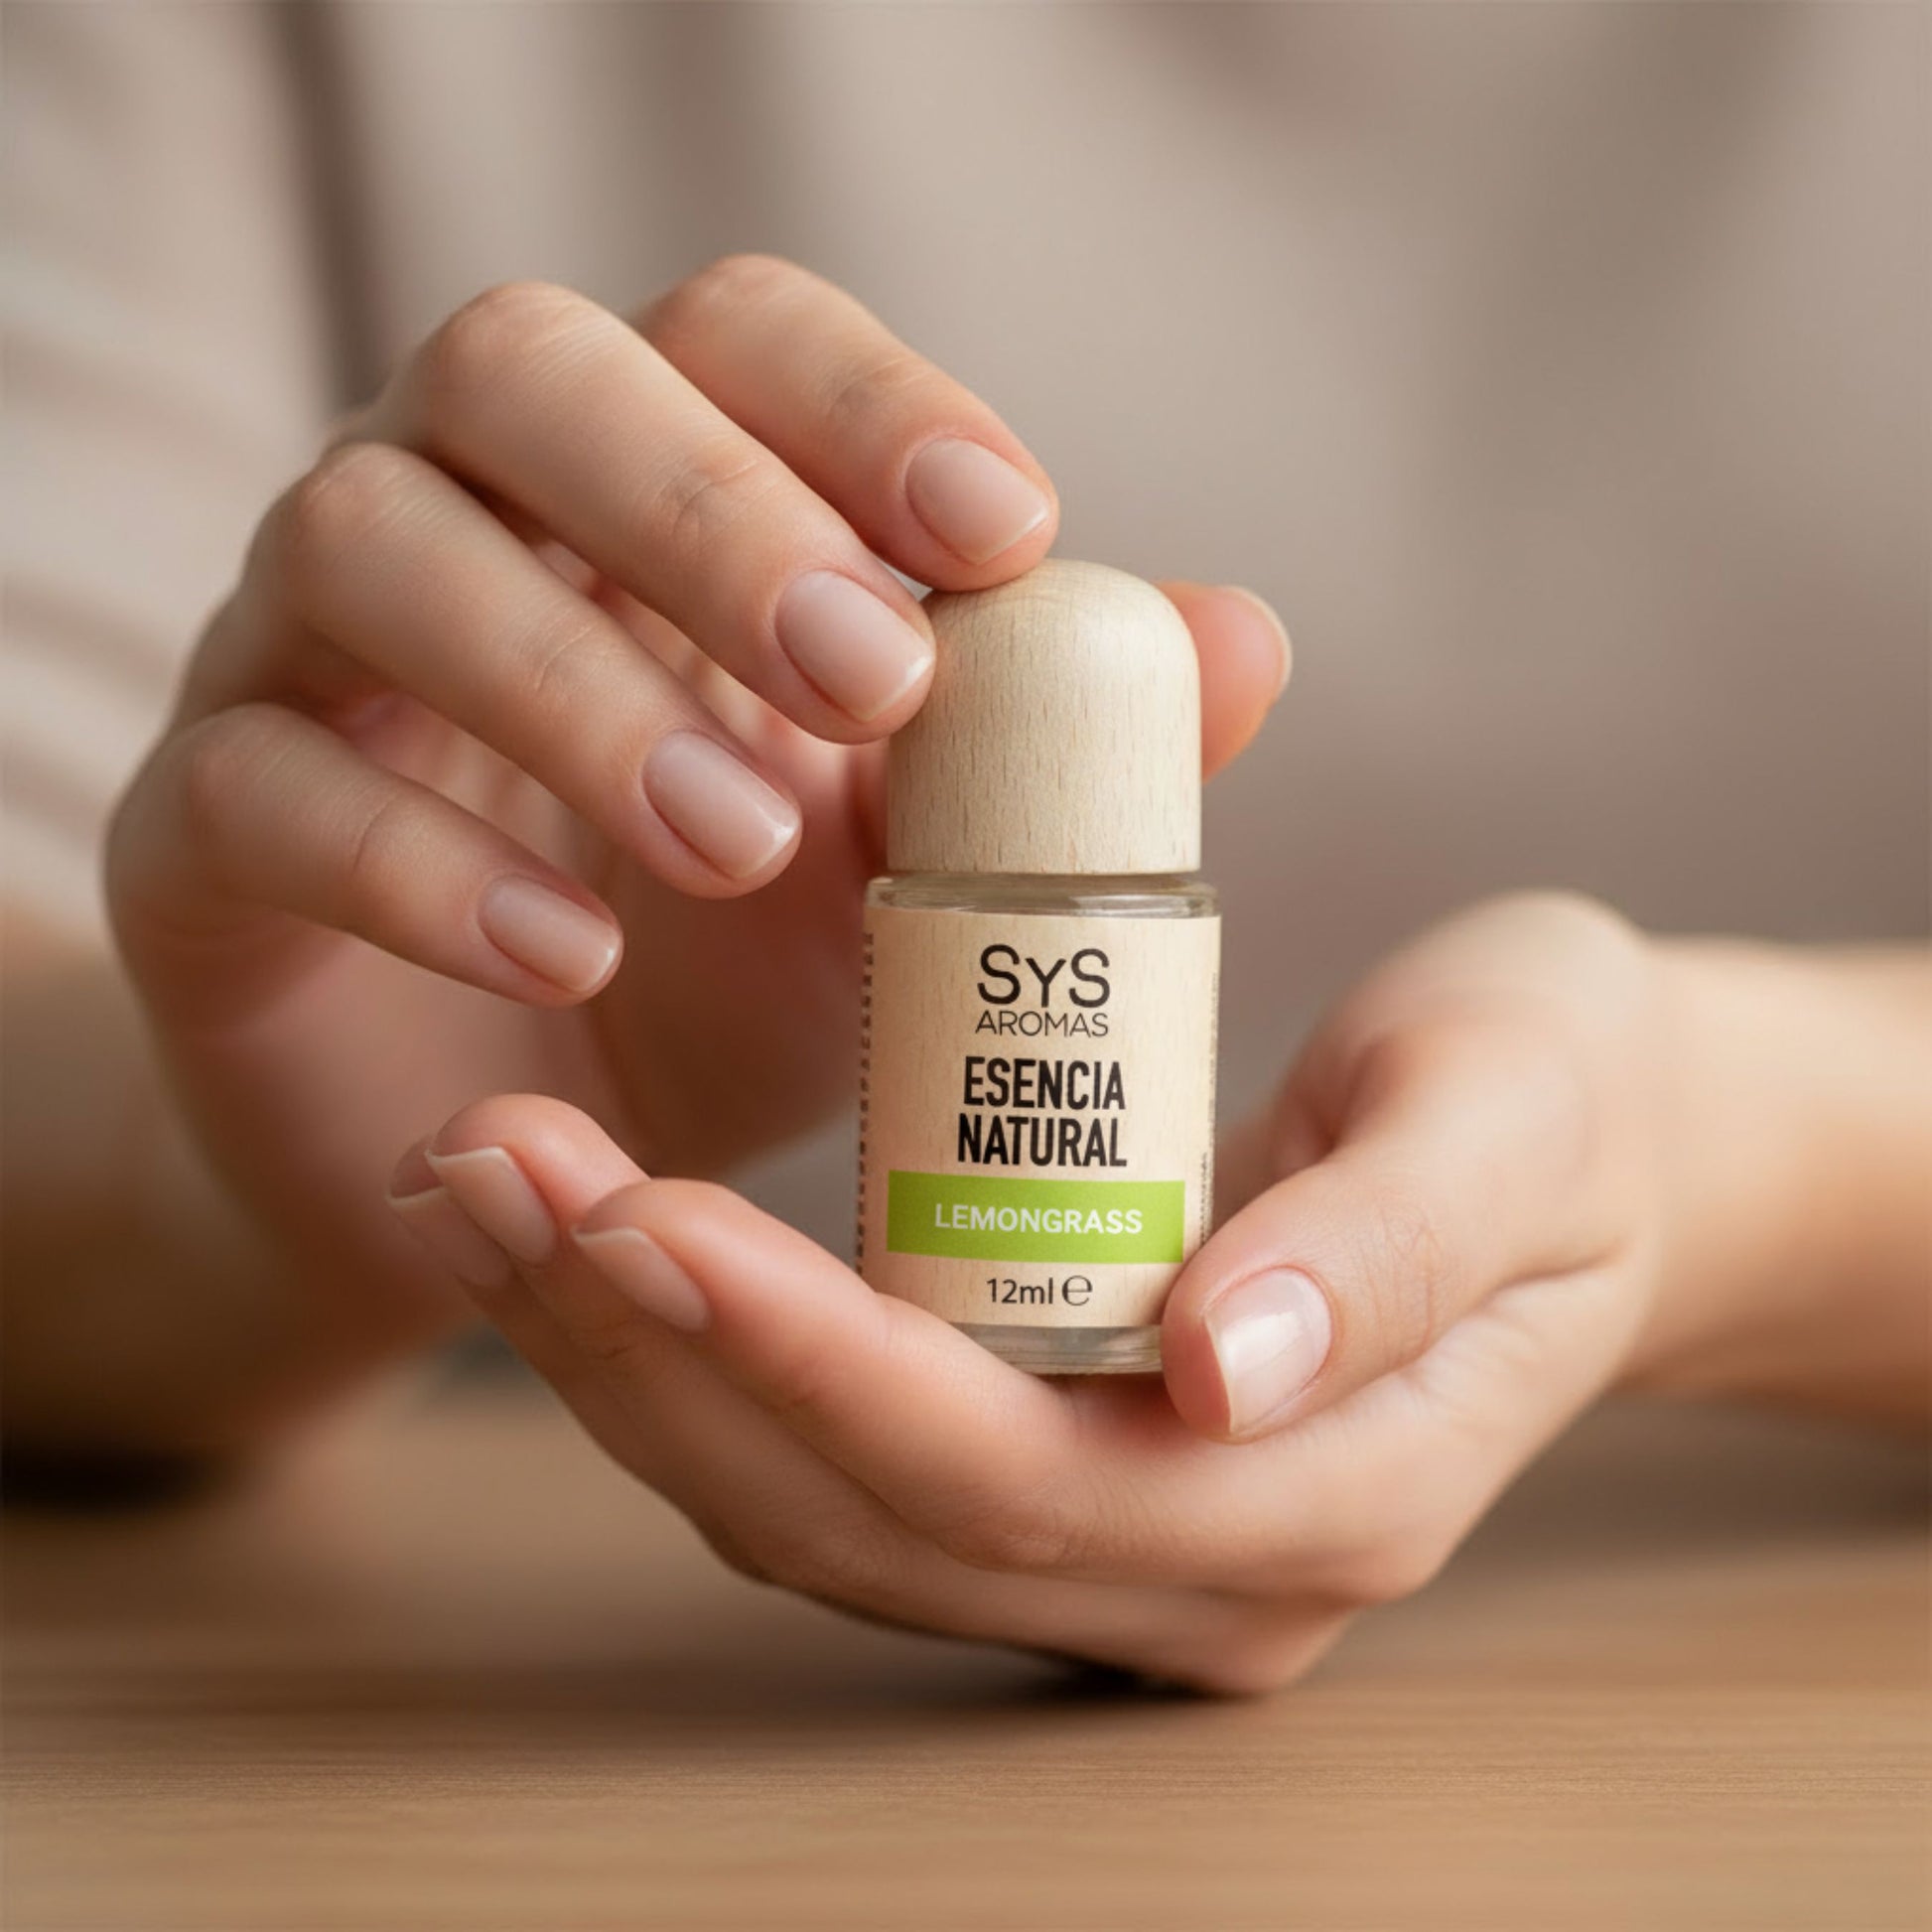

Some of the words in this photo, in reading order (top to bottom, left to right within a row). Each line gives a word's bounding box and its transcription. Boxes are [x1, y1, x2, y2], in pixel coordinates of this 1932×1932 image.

[975, 1009, 1110, 1037] AROMAS
[964, 1055, 1126, 1111] ESENCIA
[958, 1113, 1128, 1168] NATURAL
[935, 1204, 1144, 1236] LEMONGRASS
[986, 1277, 1054, 1306] 12ml
